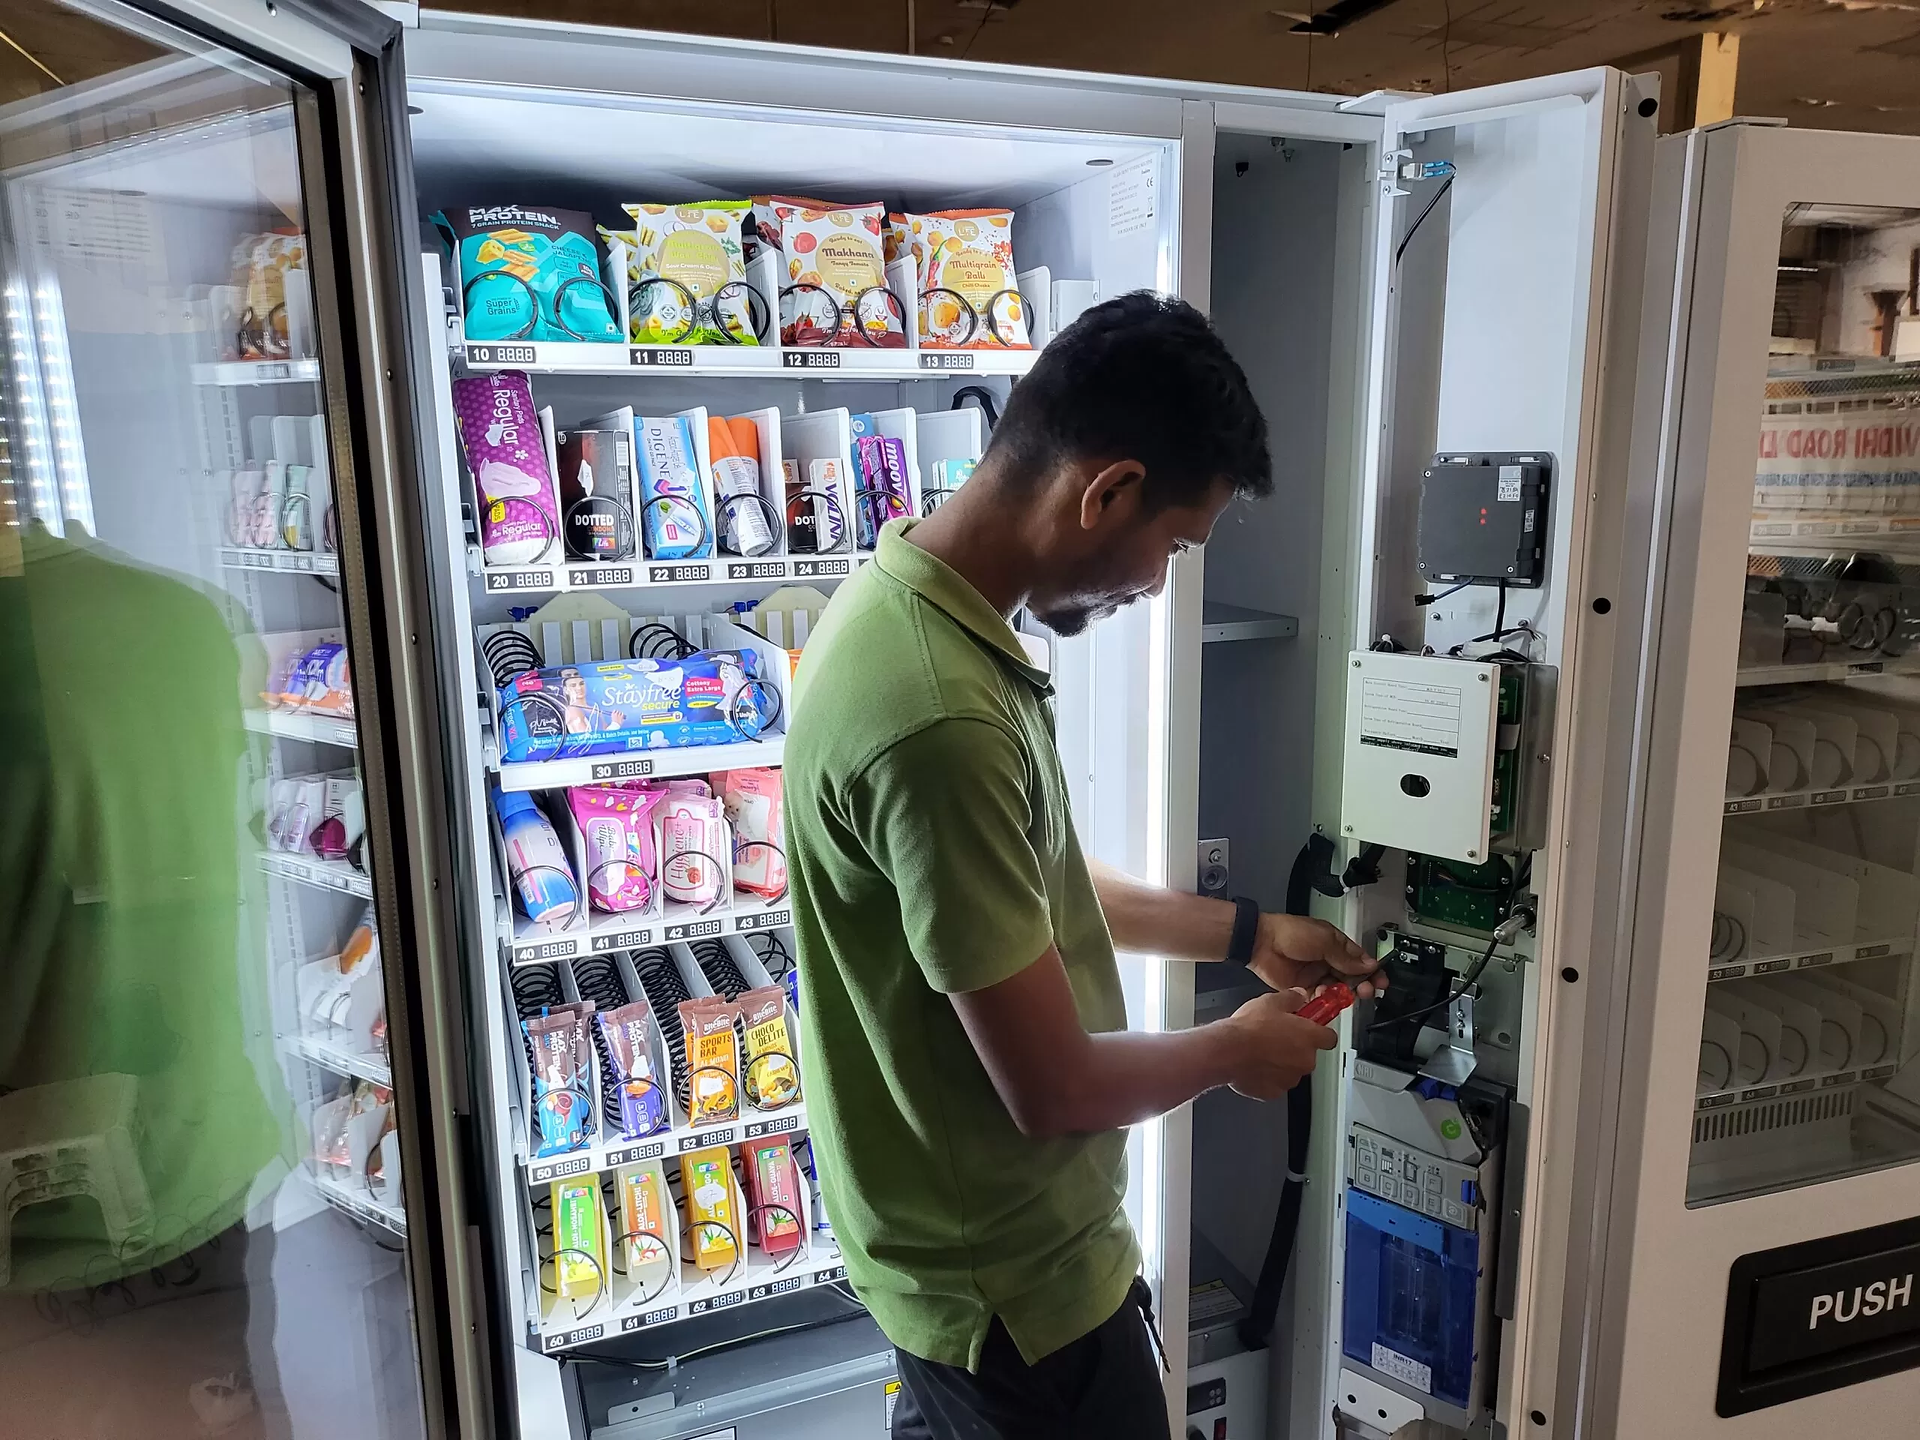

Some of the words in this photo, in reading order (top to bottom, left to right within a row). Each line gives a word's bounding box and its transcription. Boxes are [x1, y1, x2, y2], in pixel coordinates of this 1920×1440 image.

[469, 204, 519, 216] MAX
[470, 211, 558, 224] PROTEIN
[534, 221, 559, 230] SNACK
[822, 247, 874, 259] Makhana
[950, 260, 997, 270] Multigrain
[965, 270, 986, 280] Balls
[486, 298, 512, 311] Super
[487, 306, 517, 316] Grains
[473, 348, 490, 361] 10
[635, 351, 649, 364] 11
[788, 354, 802, 366] 12
[926, 356, 939, 367] 13
[493, 389, 519, 445] Regular
[650, 428, 671, 480] DIGENE
[575, 513, 615, 526] DOTTED
[794, 516, 816, 526] DOT
[502, 523, 541, 536] Regular
[654, 568, 670, 581] 22
[732, 565, 747, 578] 23
[799, 564, 813, 575] 24
[492, 575, 509, 588] 20
[573, 571, 588, 585] 21
[602, 683, 682, 708] Stayfree
[642, 700, 680, 711] secure
[596, 766, 611, 778] 30
[739, 917, 754, 929] 43
[668, 927, 684, 939] 42
[595, 937, 610, 949] 41
[519, 948, 535, 960] 40
[576, 1019, 585, 1042] MAX
[633, 1019, 645, 1043] MAX
[751, 1023, 775, 1040] CHOCO
[556, 1030, 568, 1054] MAX
[627, 1022, 640, 1059] PROTEIN
[700, 1033, 732, 1049] SPORTS
[758, 1027, 786, 1047] DELITE
[700, 1047, 718, 1058] BAR
[749, 1123, 762, 1135] 53
[682, 1138, 697, 1149] 52
[609, 1152, 624, 1164] 51
[536, 1168, 552, 1180] 50
[818, 1271, 831, 1282] 64
[752, 1286, 766, 1298] 63
[693, 1301, 707, 1313] 62
[1809, 1274, 1914, 1330] PUSH
[625, 1317, 639, 1329] 61
[549, 1335, 564, 1348] 60
